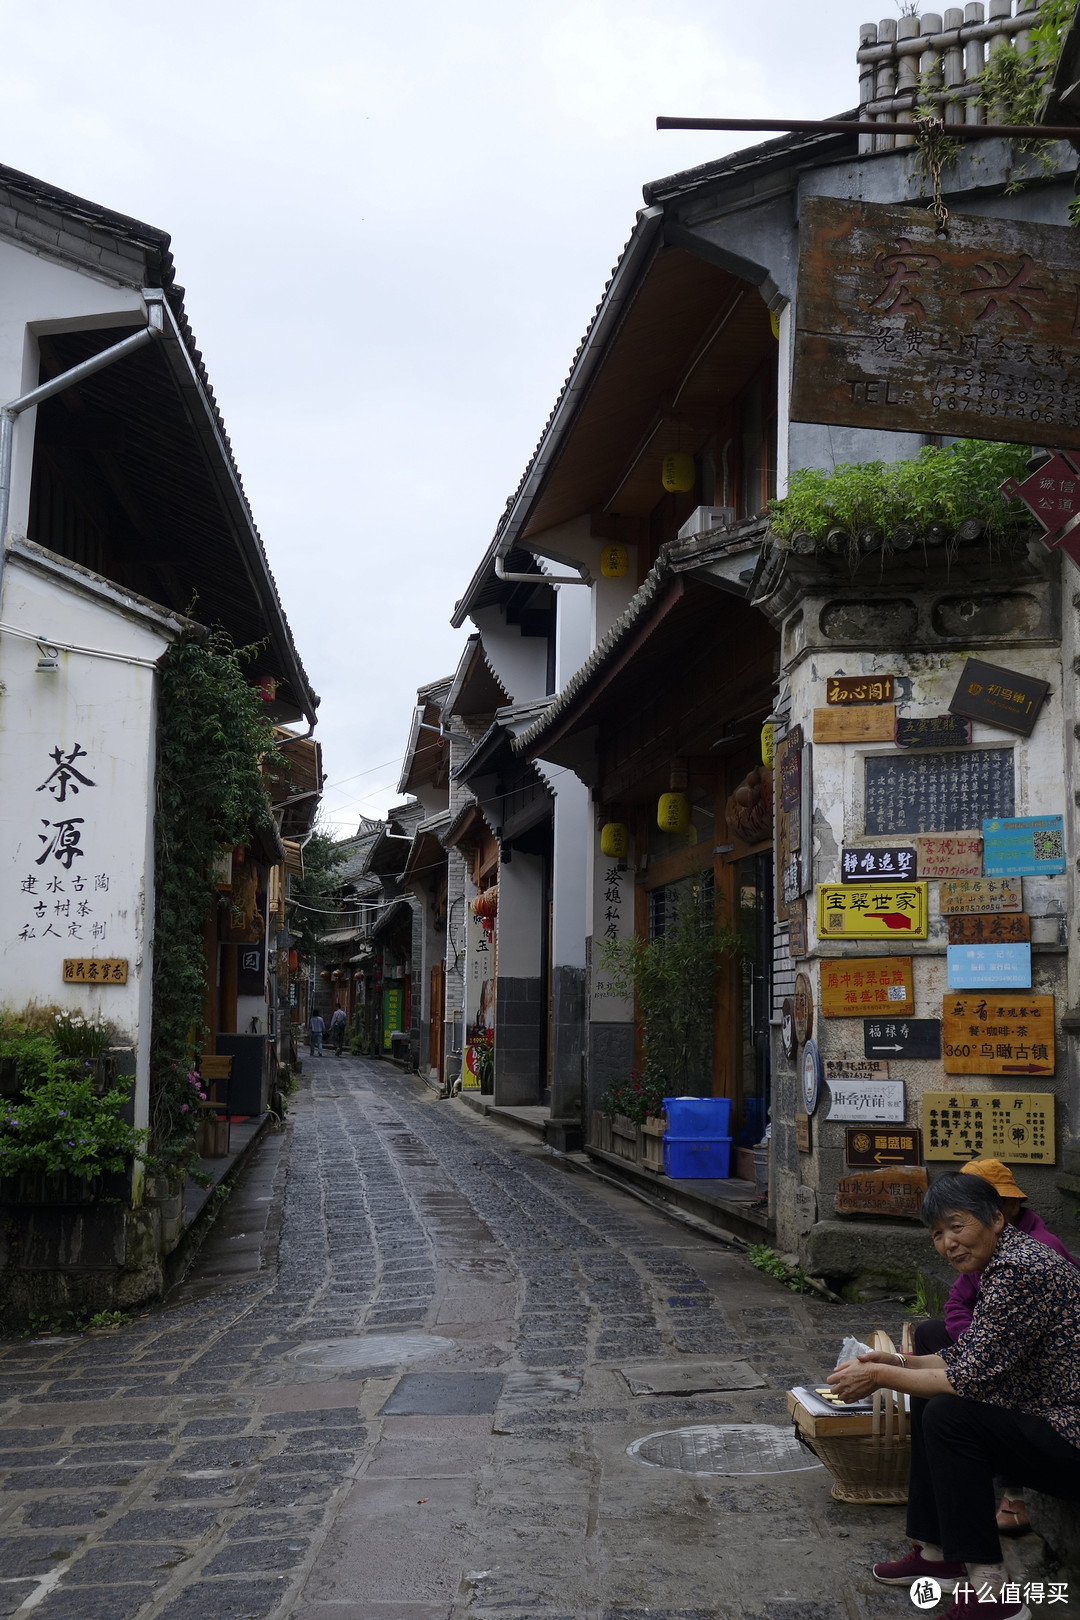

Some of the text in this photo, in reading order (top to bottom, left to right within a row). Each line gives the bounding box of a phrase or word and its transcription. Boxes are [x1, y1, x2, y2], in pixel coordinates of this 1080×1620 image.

[868, 237, 1080, 336] 宏兴
[1038, 497, 1074, 513] 公道
[35, 743, 98, 870] 茶源
[923, 840, 979, 855] 客栈出租
[20, 873, 110, 895] 建水古陶
[33, 899, 93, 919] 古树茶
[826, 892, 916, 911] 宝翠世家
[18, 921, 107, 941] 私人定制
[845, 988, 888, 1004] 福盛隆
[868, 1023, 910, 1039] 福禄寿
[945, 1043, 1049, 1060] 360°鸟瞰古镇
[874, 1135, 913, 1150] 福盛隆
